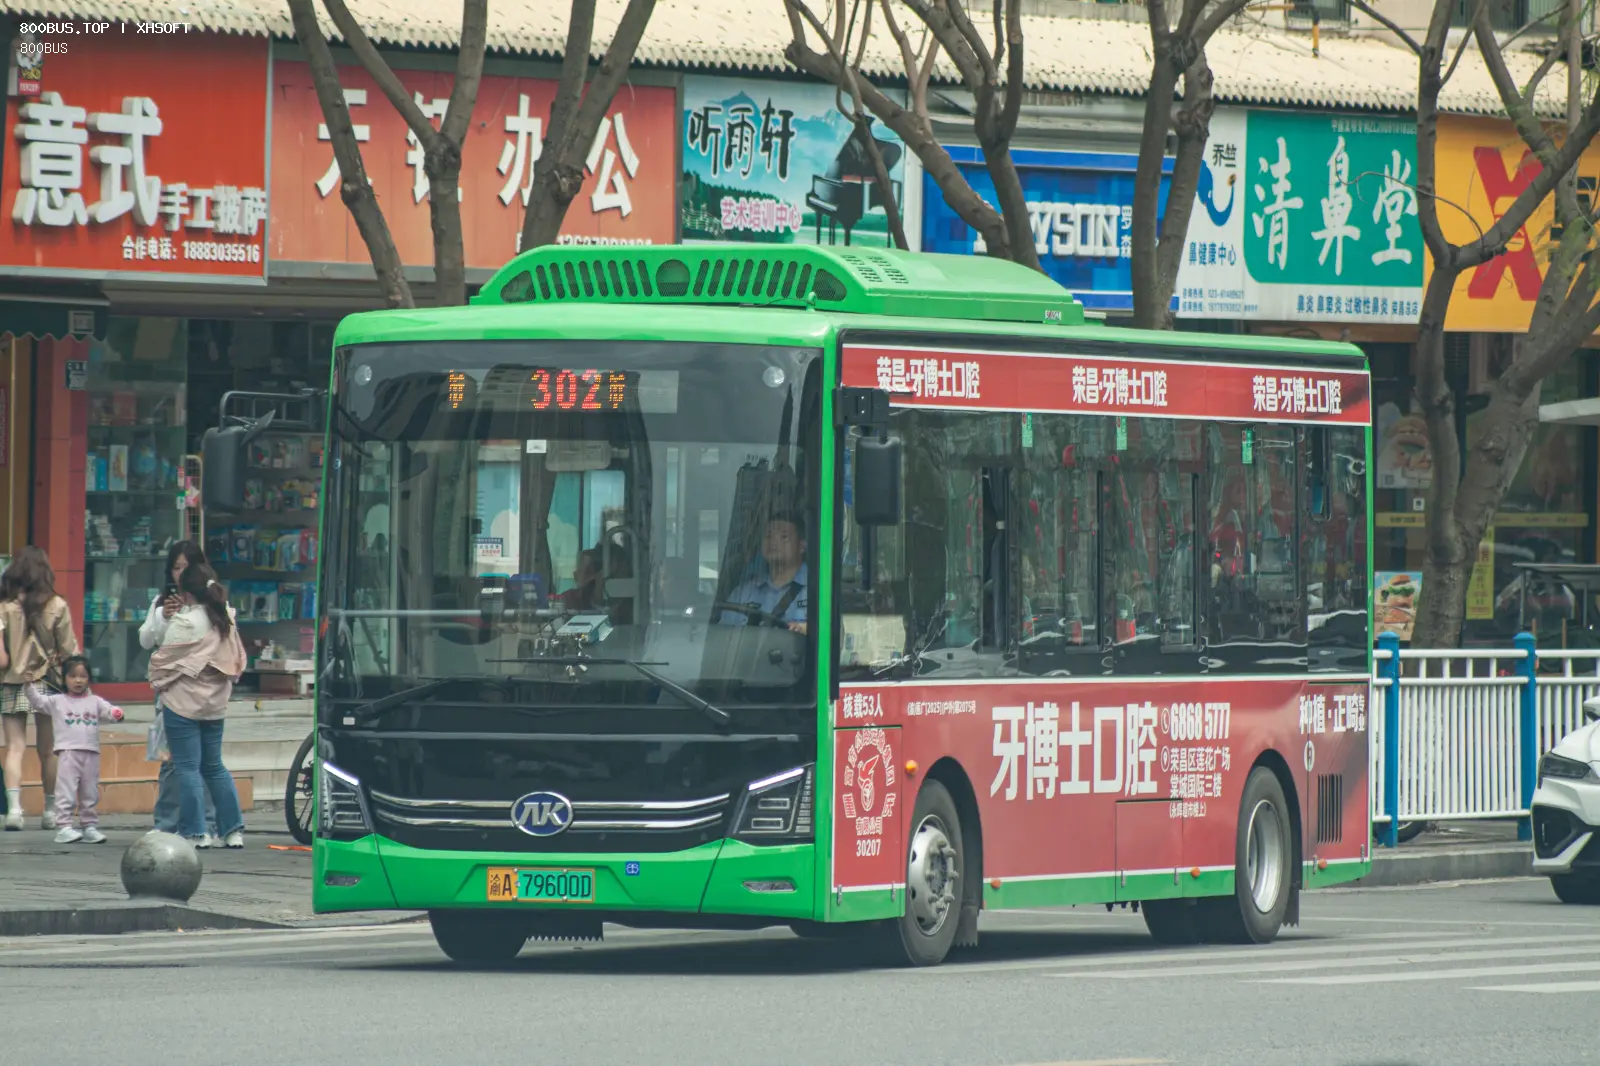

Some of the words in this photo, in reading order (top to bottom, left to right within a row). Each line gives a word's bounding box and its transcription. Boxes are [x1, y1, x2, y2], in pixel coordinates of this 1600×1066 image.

[688, 96, 797, 182] 听雨轩
[12, 91, 163, 227] 意式
[158, 182, 267, 236] 手工披萨
[720, 196, 803, 233] 艺术培训中心
[1252, 136, 1418, 277] 清鼻堂
[1189, 241, 1237, 267] 鼻健康中心
[1296, 294, 1314, 314] 鼻炎
[531, 368, 602, 410] 302
[1072, 365, 1168, 408] 荣昌·牙博士口腔
[1252, 375, 1342, 415] 荣昌·牙博士口腔
[843, 692, 884, 719] 核载53人
[1170, 702, 1203, 741] 6868
[1204, 702, 1231, 740] 5777
[990, 701, 1158, 801] 牙博士口腔
[1170, 746, 1231, 772] 荣昌区莲花广场
[1170, 772, 1222, 799] 棠城国际三楼
[856, 839, 882, 857] 30207
